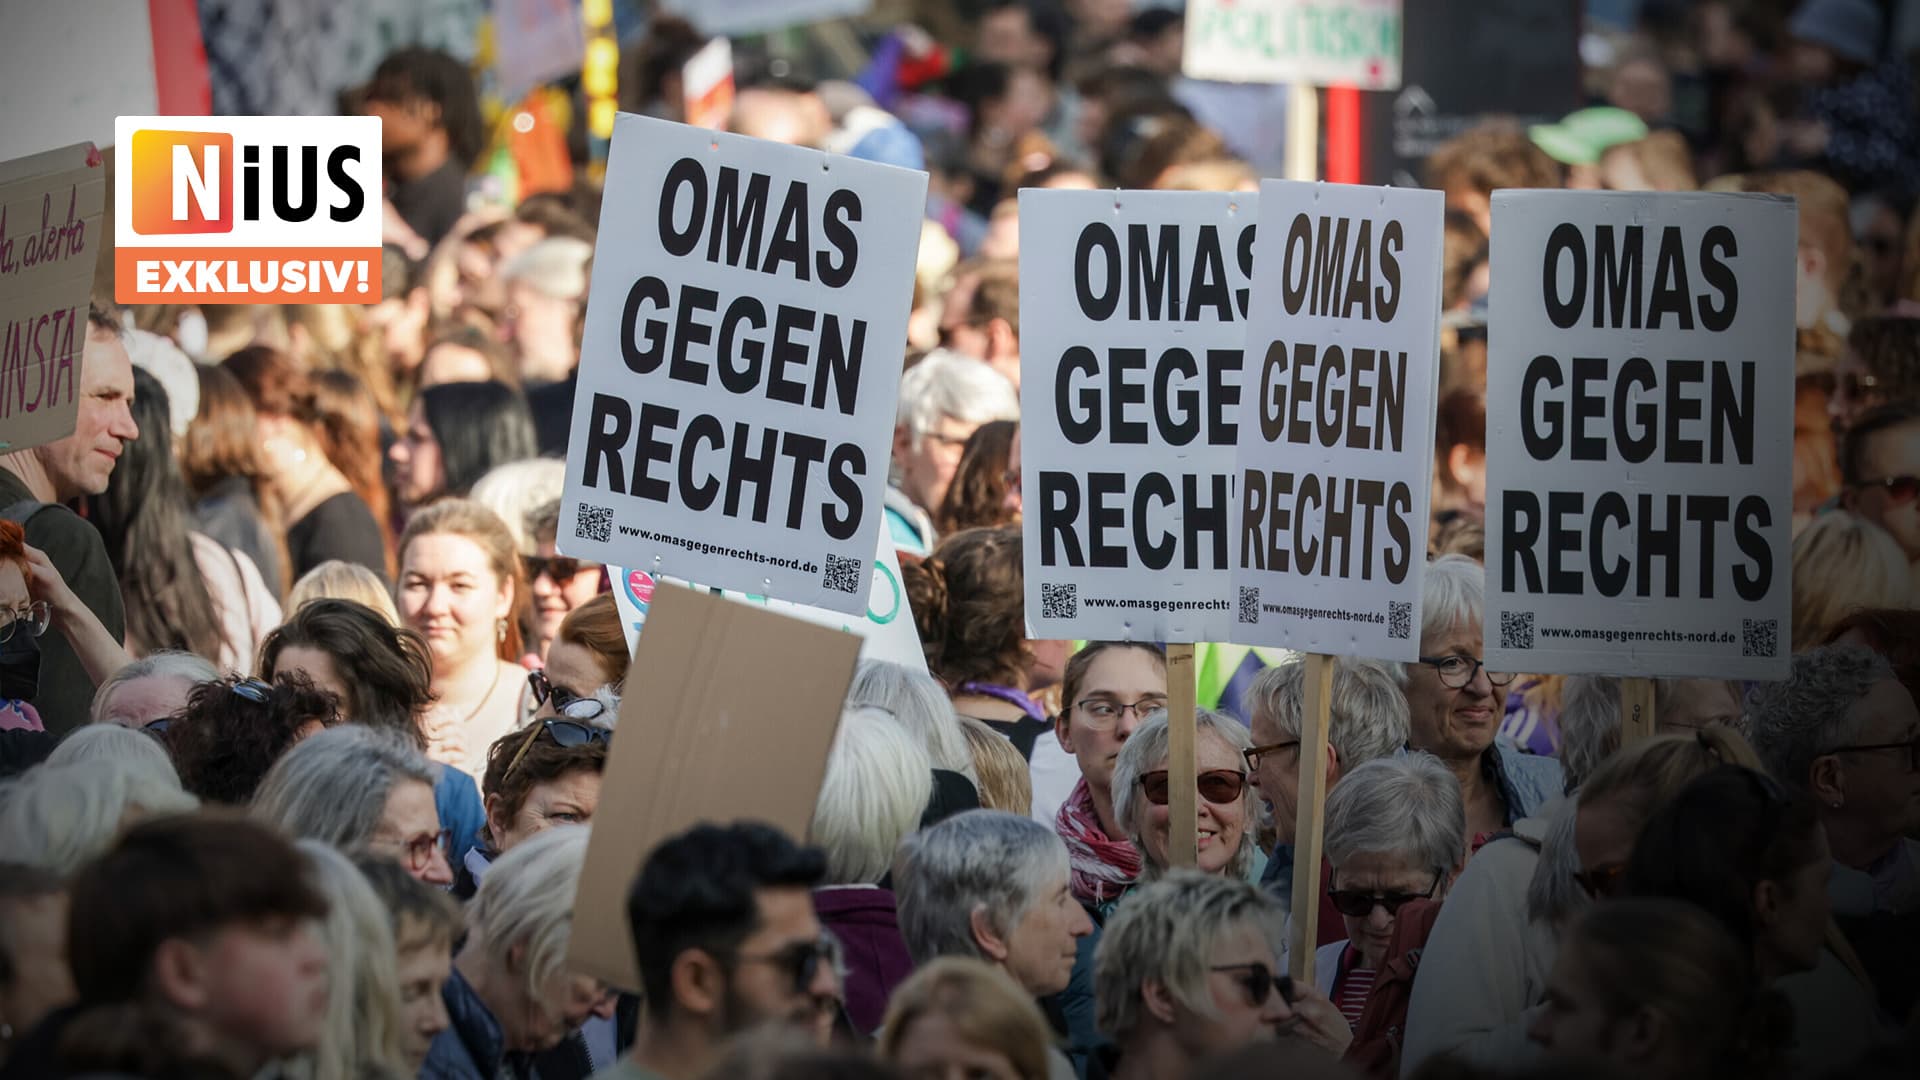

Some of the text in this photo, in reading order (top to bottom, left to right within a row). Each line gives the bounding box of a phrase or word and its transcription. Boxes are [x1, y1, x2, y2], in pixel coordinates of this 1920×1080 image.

[23, 183, 85, 266] alerta
[658, 157, 862, 289] OMAS
[1282, 213, 1404, 323] OMAS
[1543, 222, 1739, 333] OMAS
[620, 275, 868, 416] GEGEN
[1259, 340, 1408, 453] GEGEN
[1520, 355, 1756, 466] GEGEN
[582, 392, 868, 541] RECHTS
[1039, 471, 1236, 571] RECH
[618, 525, 818, 574] www.omasgegenrechts-nord.de
[1240, 468, 1412, 585] RECHTS
[1501, 490, 1774, 603] RECHTS
[1262, 603, 1385, 625] www.omasgegenrechts-nord.de
[1540, 627, 1736, 643] www.omasgegenrechts-nord.de
